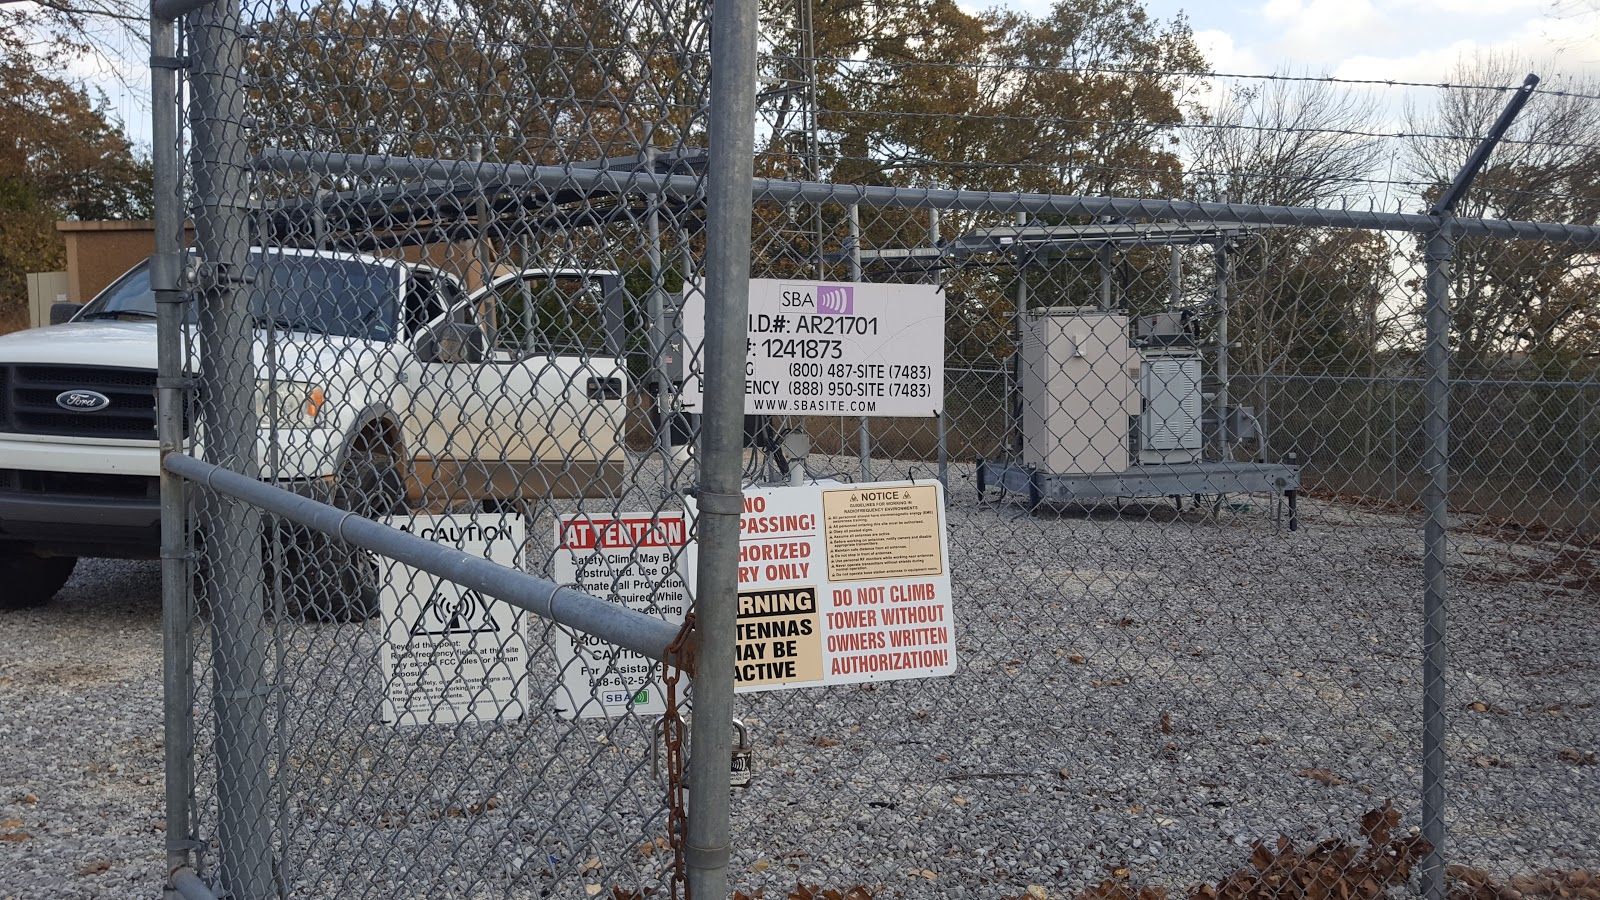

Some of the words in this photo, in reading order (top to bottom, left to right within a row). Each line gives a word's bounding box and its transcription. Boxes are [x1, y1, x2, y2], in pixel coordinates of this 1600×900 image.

[782, 291, 814, 308] SBA
[796, 316, 878, 335] AR21701
[761, 339, 842, 358] 1241873
[788, 362, 823, 378] (800)
[828, 363, 884, 379] 487-SITE
[889, 364, 931, 380] (7483)
[788, 382, 823, 396] (888)
[828, 382, 884, 397] 950-SITE
[889, 383, 931, 398] (7483)
[67, 394, 96, 406] Ford
[754, 400, 876, 412] WWW.SBASITE.COM
[742, 496, 765, 514] NO
[862, 492, 899, 501] NOTICE
[740, 514, 816, 534] PASSING!
[566, 522, 682, 546] ATTENTION
[640, 553, 660, 564] May
[739, 542, 811, 562] HORIZED
[766, 563, 810, 581] ONLY
[737, 592, 813, 615] RNING
[833, 590, 852, 606] DO
[857, 587, 885, 605] NOT
[889, 584, 935, 602] CLIMB
[826, 610, 876, 630] TOWER
[881, 605, 944, 626] WITHOUT
[736, 619, 813, 640] TENNAS
[827, 632, 886, 652] OWNERS
[889, 627, 948, 647] WRITTEN
[773, 641, 797, 658] BE
[831, 650, 948, 676] AUTHORIZATION!
